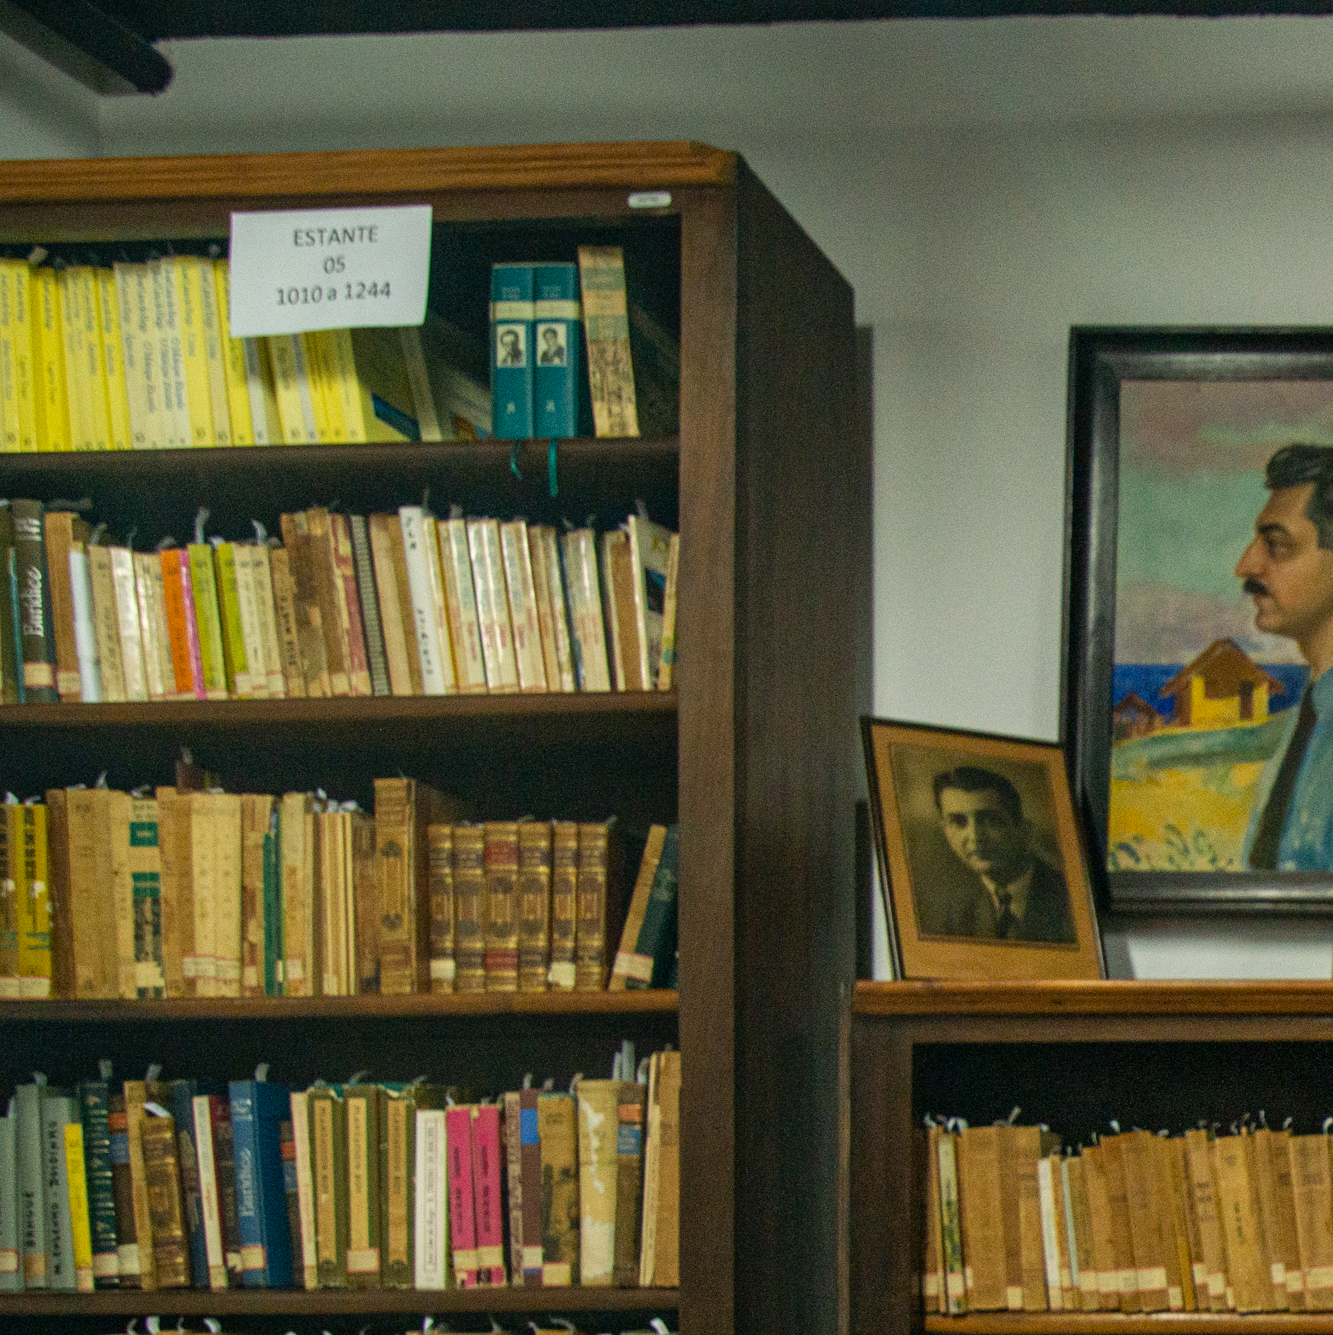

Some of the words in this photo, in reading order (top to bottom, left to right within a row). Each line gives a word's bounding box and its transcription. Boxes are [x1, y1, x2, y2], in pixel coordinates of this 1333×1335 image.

[294, 226, 378, 247] ESTANTE
[323, 256, 345, 274] 05
[277, 286, 323, 306] 1010
[327, 288, 337, 301] a
[345, 280, 391, 299] 1244
